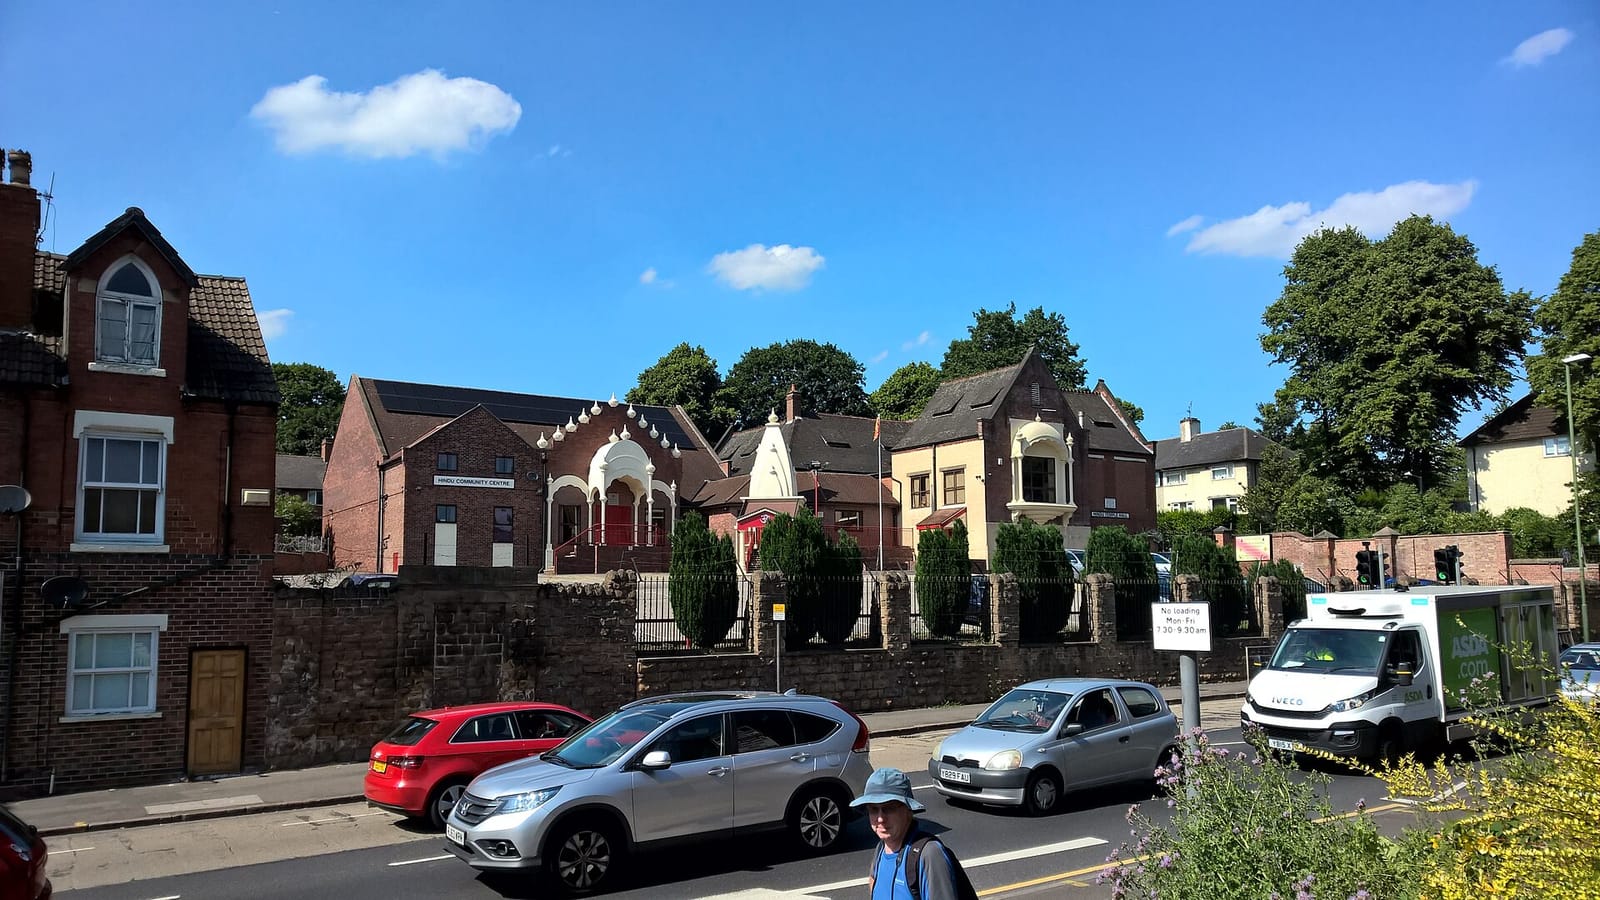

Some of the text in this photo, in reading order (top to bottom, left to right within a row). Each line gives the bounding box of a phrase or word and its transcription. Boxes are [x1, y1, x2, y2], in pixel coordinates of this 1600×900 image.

[1173, 607, 1200, 615] loading
[1452, 634, 1489, 659] ASDA
[1458, 660, 1489, 679] .com
[1271, 696, 1303, 706] IVECO
[1404, 690, 1423, 702] ASDA
[957, 772, 969, 781] FAU
